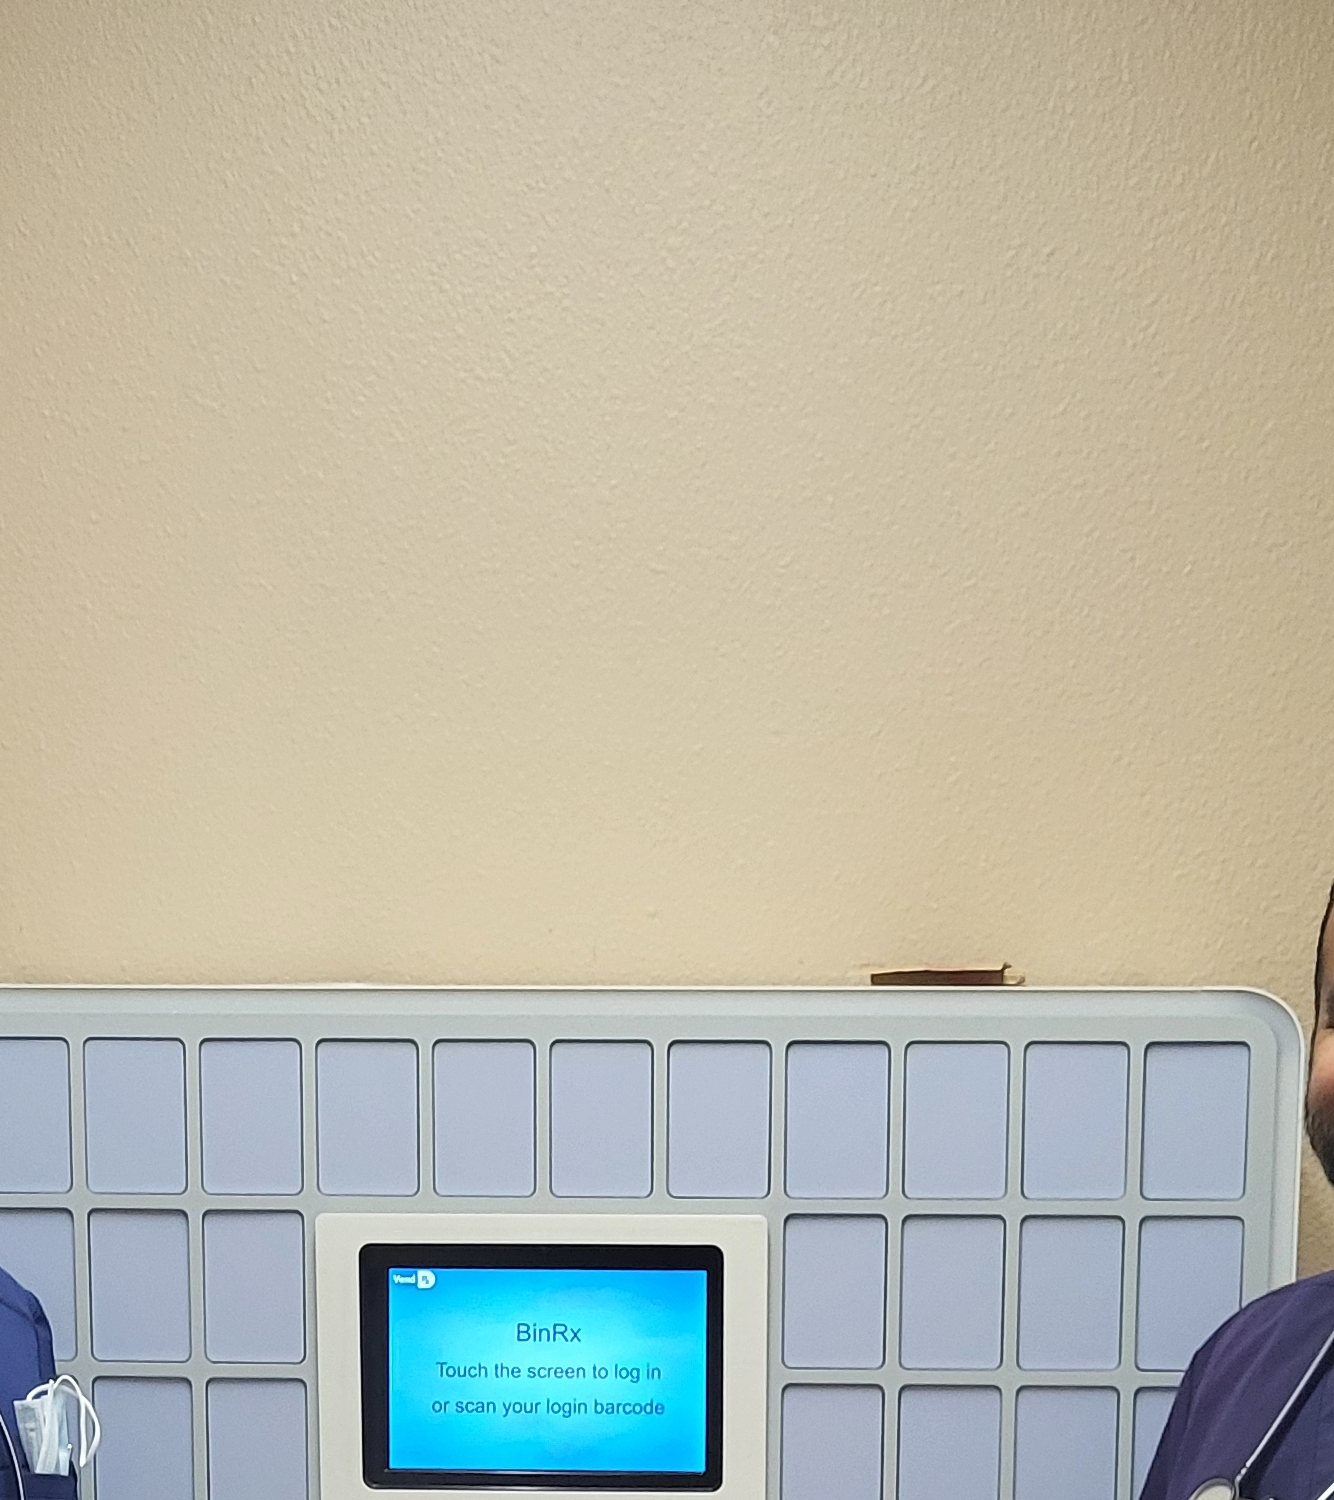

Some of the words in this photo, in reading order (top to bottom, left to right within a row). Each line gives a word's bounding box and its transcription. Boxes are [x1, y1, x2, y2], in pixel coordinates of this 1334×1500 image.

[516, 1323, 582, 1343] BinRx
[436, 1362, 488, 1379] Touch
[494, 1363, 521, 1379] the
[527, 1366, 585, 1379] screen
[592, 1364, 608, 1379] to
[615, 1363, 640, 1383] log
[646, 1363, 661, 1379] in
[431, 1400, 449, 1414] or
[455, 1400, 496, 1414] scan
[502, 1400, 541, 1417] your
[546, 1398, 588, 1418] login
[594, 1398, 665, 1415] barcode
